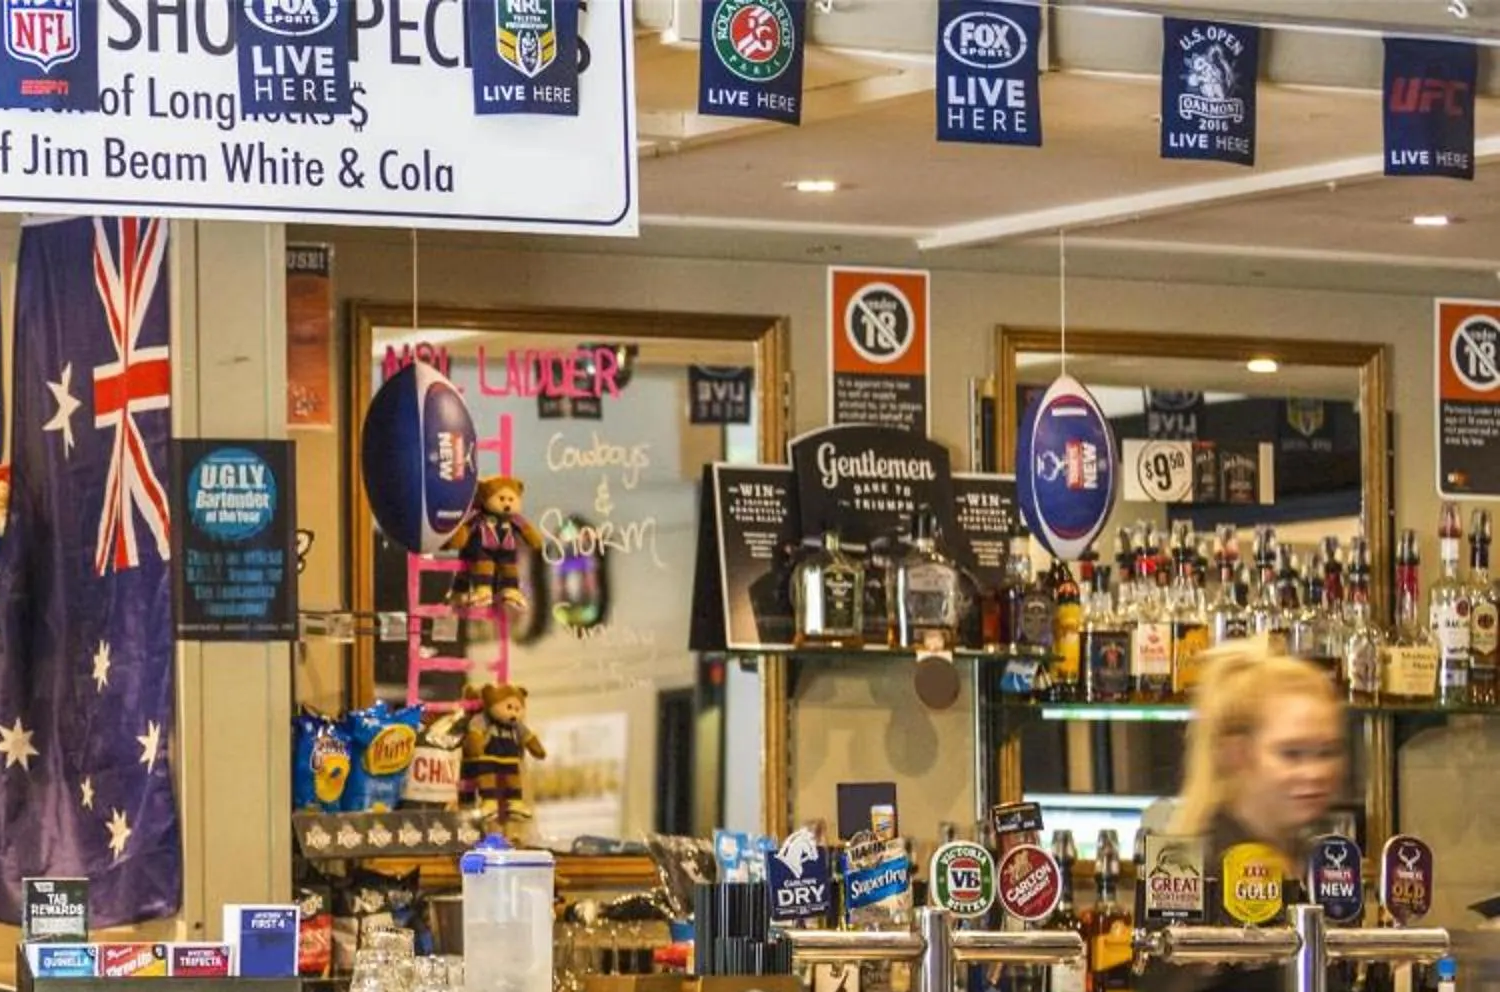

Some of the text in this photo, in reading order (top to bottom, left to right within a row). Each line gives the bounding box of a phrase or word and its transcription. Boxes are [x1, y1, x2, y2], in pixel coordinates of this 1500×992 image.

[14, 11, 72, 54] NFL
[107, 0, 235, 56] SHO
[960, 22, 1011, 47] FOX
[960, 47, 1012, 58] SPORTS
[1207, 26, 1245, 56] OPEN
[252, 45, 335, 76] LIVE
[100, 73, 134, 117] of
[254, 79, 337, 102] HERE
[483, 85, 571, 103] LIVE HERE
[707, 89, 796, 113] LIVE HERE
[947, 76, 1026, 108] LIVE
[1389, 77, 1470, 116] UFC
[1183, 98, 1242, 117] OAKMONT
[947, 108, 1028, 133] HERE
[1169, 132, 1249, 153] LIVE HERE
[23, 134, 89, 178] Jim
[104, 138, 208, 182] Beam
[222, 143, 325, 186] White
[338, 148, 366, 188] &
[379, 149, 455, 192] Cola
[1391, 150, 1469, 169] LIVE HERE
[861, 312, 898, 350] 18
[1464, 342, 1496, 378] 18
[477, 344, 623, 400] LADDER
[546, 432, 651, 491] Cowboys
[818, 442, 936, 489] Gentlemen
[195, 489, 271, 509] Bartender
[740, 483, 774, 497] WIN
[967, 492, 1000, 507] WIN
[854, 498, 914, 511] TRIUMPH
[951, 870, 980, 889] VB
[1006, 861, 1052, 902] CARLTON
[1151, 876, 1199, 893] GREAT
[1235, 880, 1280, 900] GOLD
[1321, 882, 1355, 898] NEW
[1392, 879, 1426, 899] OLD
[47, 893, 68, 905] TAB
[777, 883, 826, 907] DRY
[30, 903, 85, 918] REWARDS
[251, 917, 277, 930] FIRST
[179, 956, 222, 968] TRIFECTA
